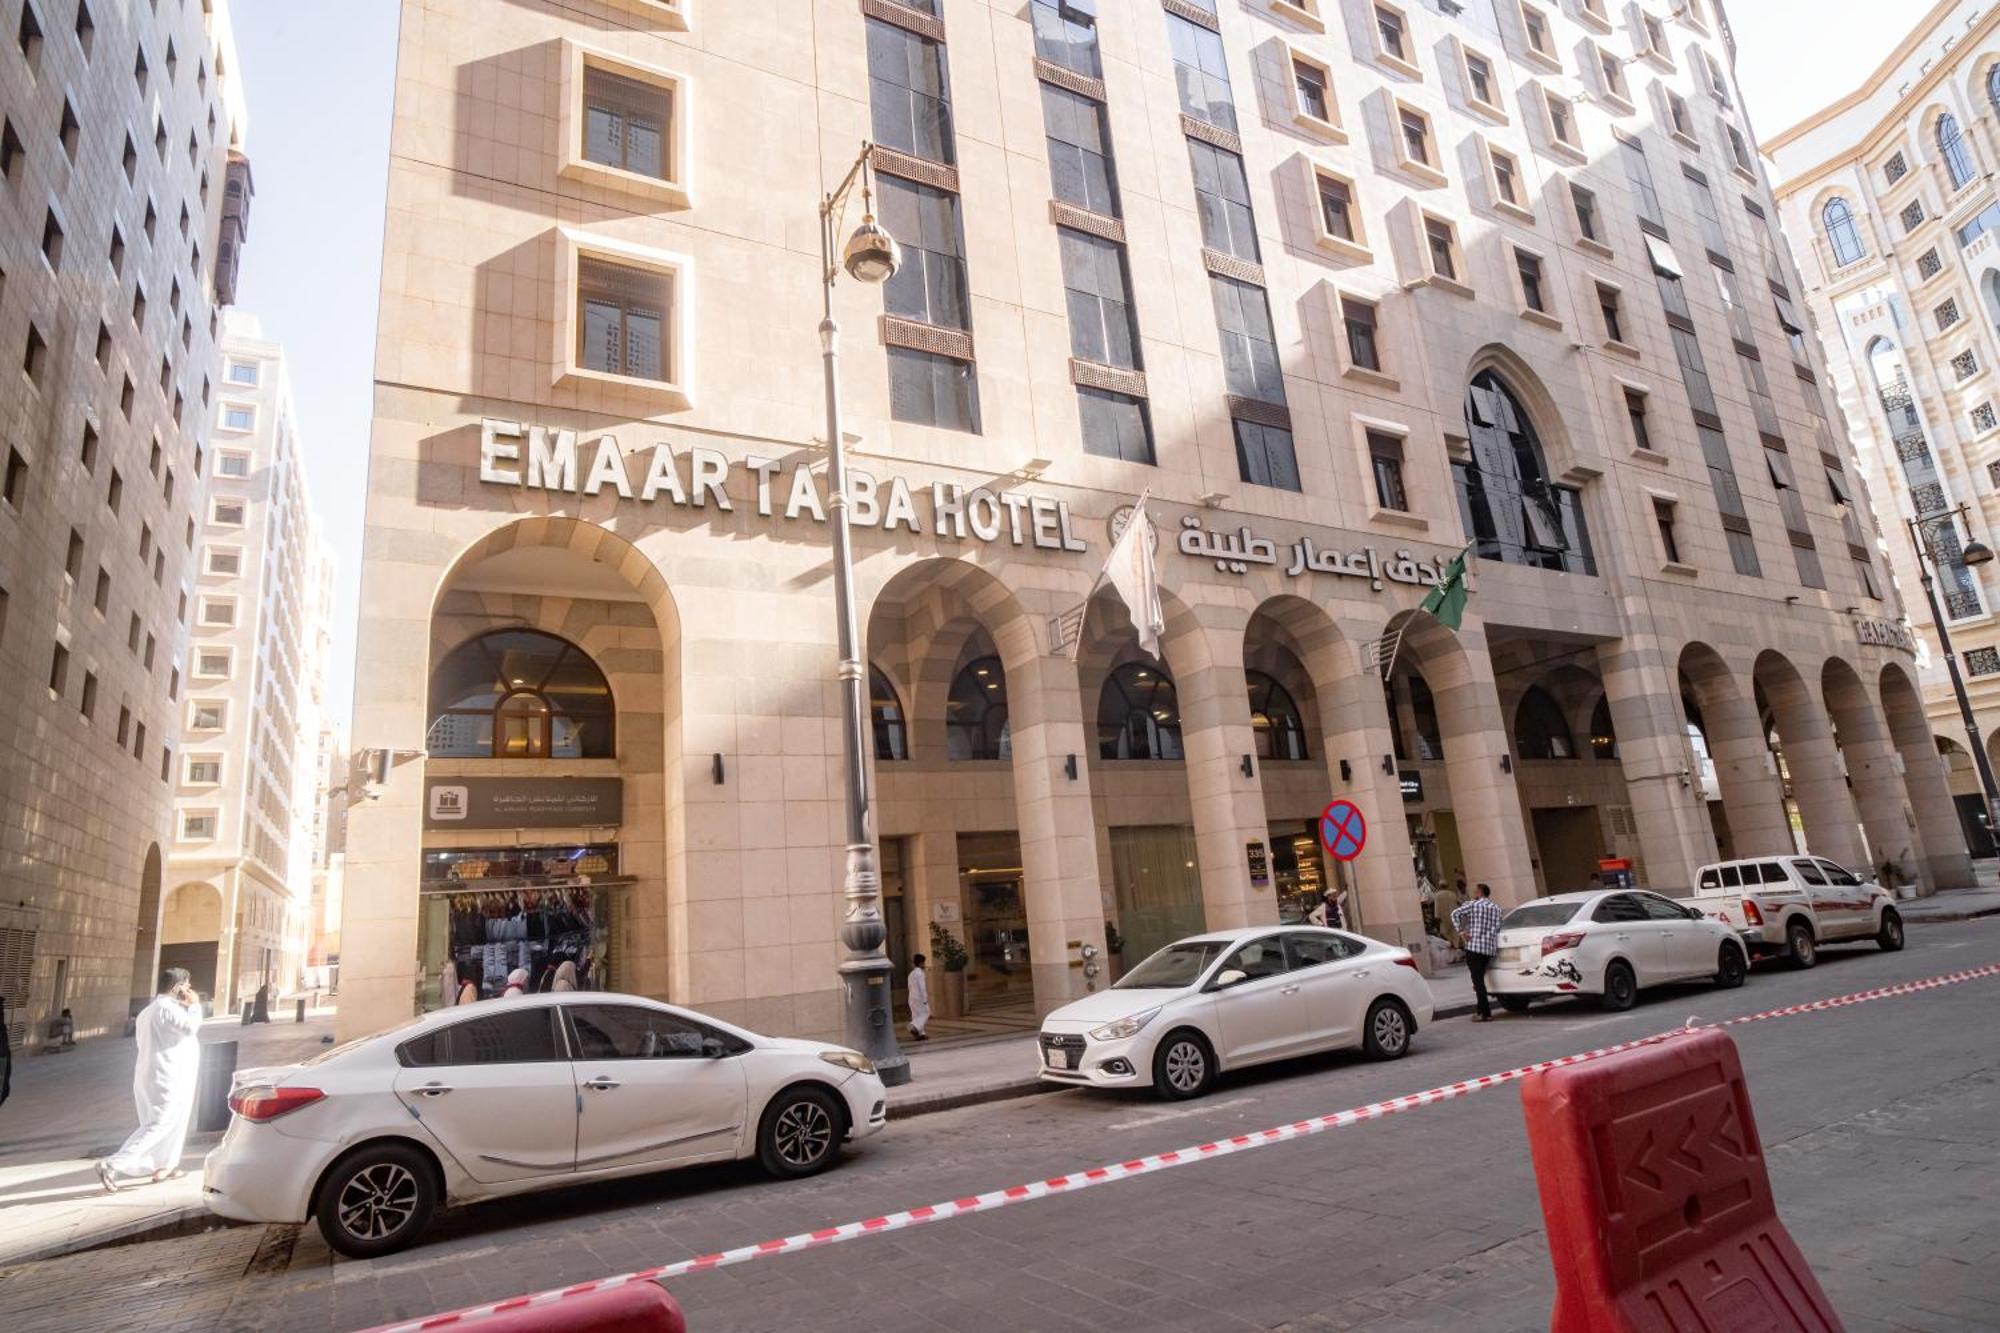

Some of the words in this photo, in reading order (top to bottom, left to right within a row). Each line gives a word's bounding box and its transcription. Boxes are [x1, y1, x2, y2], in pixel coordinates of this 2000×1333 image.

[480, 418, 733, 511] EMAAR
[746, 456, 921, 532] TABA
[932, 481, 1087, 553] HOTEL
[1179, 516, 1277, 574] طيبة
[1286, 537, 1382, 592] إعمار
[1384, 548, 1469, 588] ندق
